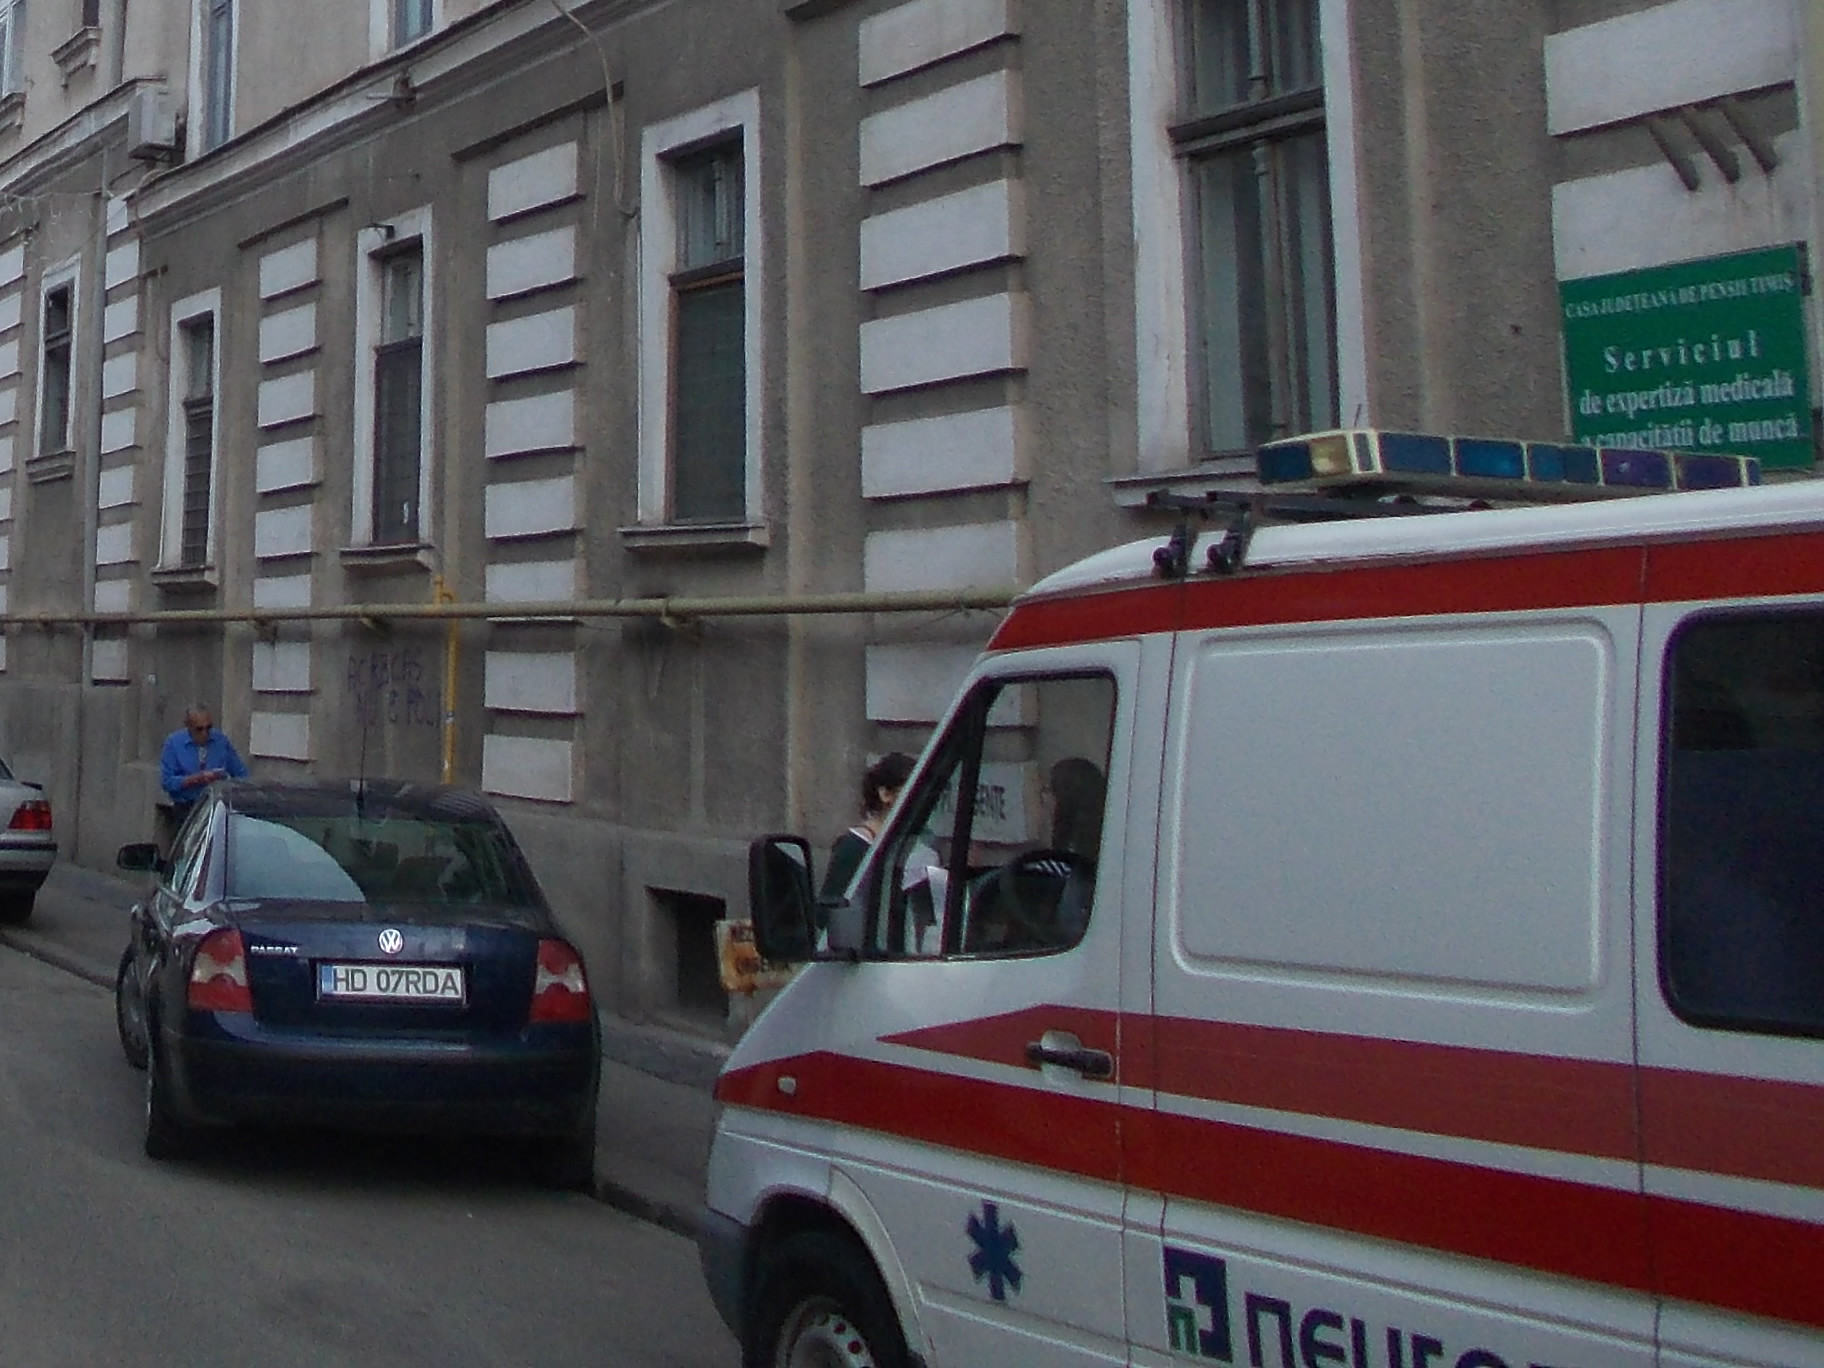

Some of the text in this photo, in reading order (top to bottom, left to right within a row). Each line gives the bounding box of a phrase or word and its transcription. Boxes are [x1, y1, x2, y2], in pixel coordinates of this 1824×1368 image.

[1603, 329, 1761, 373] Serviciul
[1579, 368, 1795, 419] de expertiză medicală
[1698, 417, 1724, 445] de
[1728, 412, 1798, 443] muncă
[333, 968, 368, 992] HD
